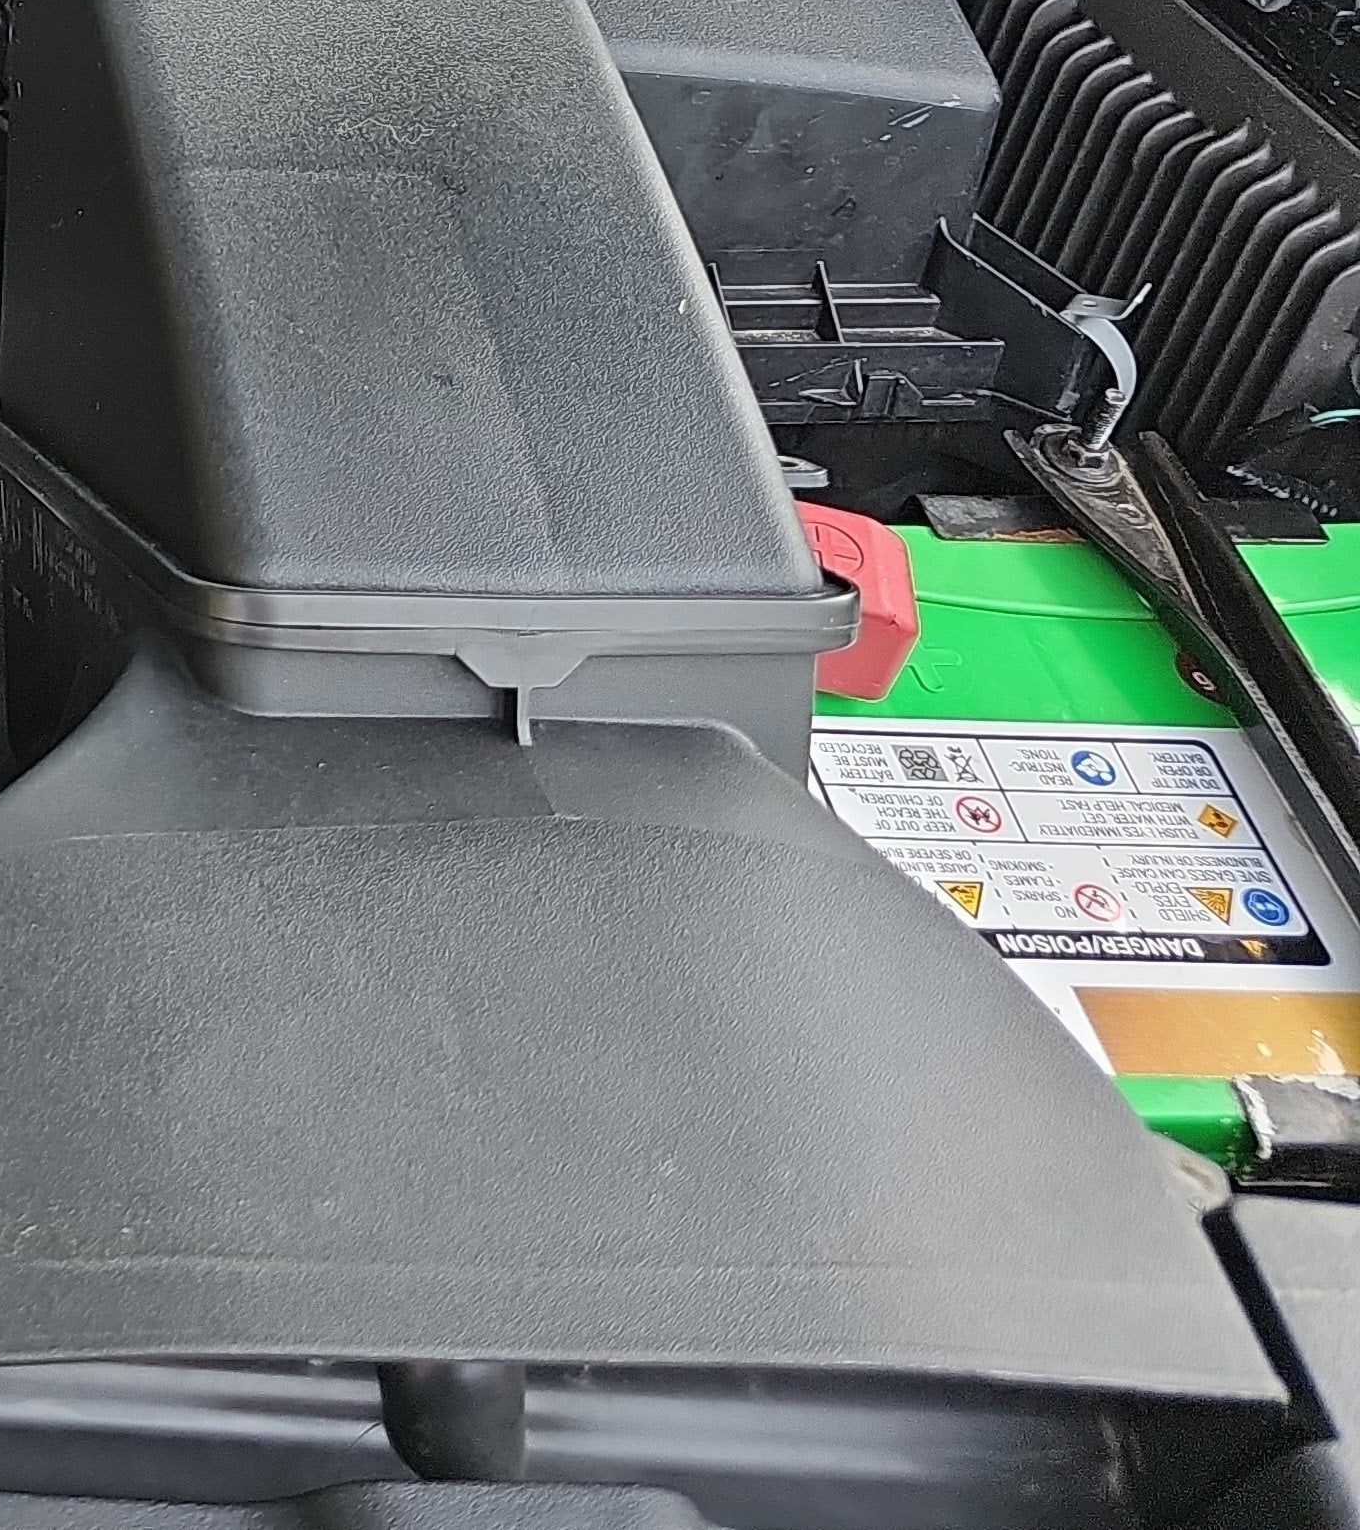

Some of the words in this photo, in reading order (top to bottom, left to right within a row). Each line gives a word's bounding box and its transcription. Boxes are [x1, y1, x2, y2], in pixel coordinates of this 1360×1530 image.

[813, 742, 882, 755] RECYCLED.
[834, 755, 849, 766] BE
[852, 756, 888, 767] MUST
[1008, 760, 1067, 773] INSTRUC-
[839, 769, 894, 781] BATTERY
[1157, 765, 1191, 776] OPEN
[1191, 766, 1213, 777] OR
[1039, 775, 1073, 786] READ
[1151, 778, 1171, 788] TIP
[1170, 778, 1198, 789] NOT
[1198, 779, 1220, 790] DO
[927, 796, 943, 806] OF
[1091, 800, 1125, 811] HELP
[1125, 801, 1184, 813] MEDICAL
[876, 807, 920, 818] REACH
[923, 808, 951, 819] THE
[1082, 812, 1106, 823] GET
[874, 820, 889, 830] OF
[892, 820, 919, 831] OUT
[1156, 814, 1191, 825] WITH
[923, 821, 956, 833] KEEP
[1038, 824, 1120, 837] IMMEDIATELY
[1159, 827, 1199, 840] FLUSH
[878, 846, 903, 858] BUR
[907, 848, 952, 860] SEVERE
[954, 849, 972, 861] OR
[987, 859, 1046, 872] SMOKING
[1175, 855, 1193, 866] OR
[1193, 855, 1264, 867] BLINDNESS
[937, 861, 978, 874] CAUSE
[1114, 867, 1156, 880] CAUSE
[1157, 868, 1186, 880] CAN
[1187, 869, 1234, 882] GASES
[1236, 870, 1271, 883] SIVE
[1003, 874, 1054, 887] FLAMES
[1130, 881, 1184, 894] EXPLO-
[1012, 889, 1061, 901] SPARKS
[1054, 906, 1078, 919] NO
[1159, 908, 1211, 921] SHIELD
[996, 933, 1205, 958] DANGER/POISON
